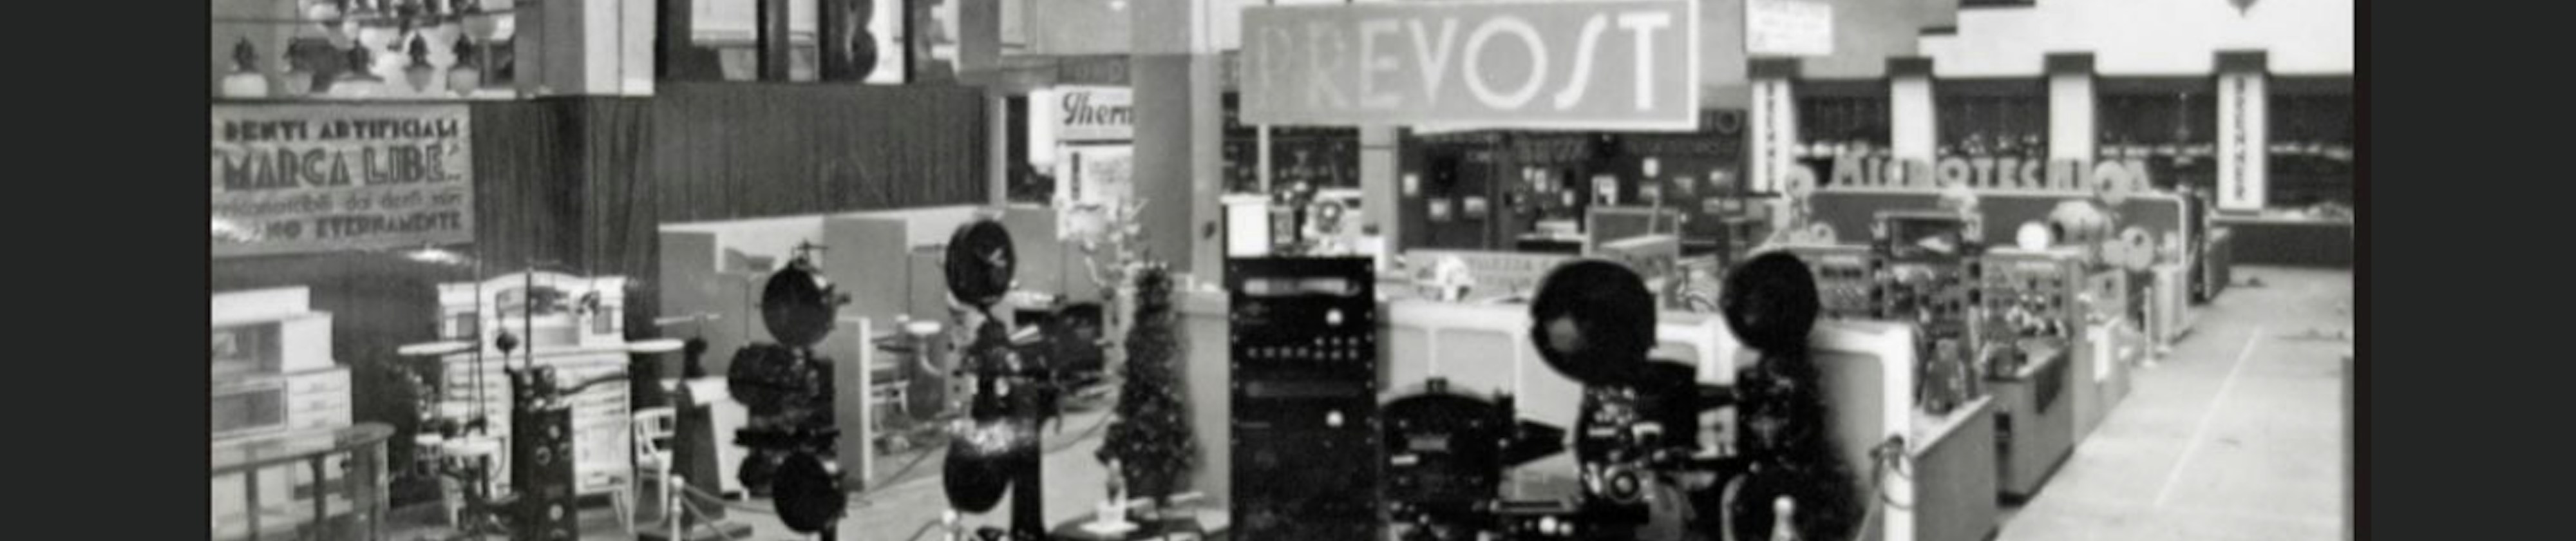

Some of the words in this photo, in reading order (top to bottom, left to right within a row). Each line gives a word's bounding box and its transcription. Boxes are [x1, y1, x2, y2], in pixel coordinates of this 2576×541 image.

[1260, 12, 1672, 111] PREVOST
[225, 119, 308, 142] DENTI
[319, 118, 457, 140] ARTIFICIALI
[1831, 155, 2152, 192] MICROTECNIA
